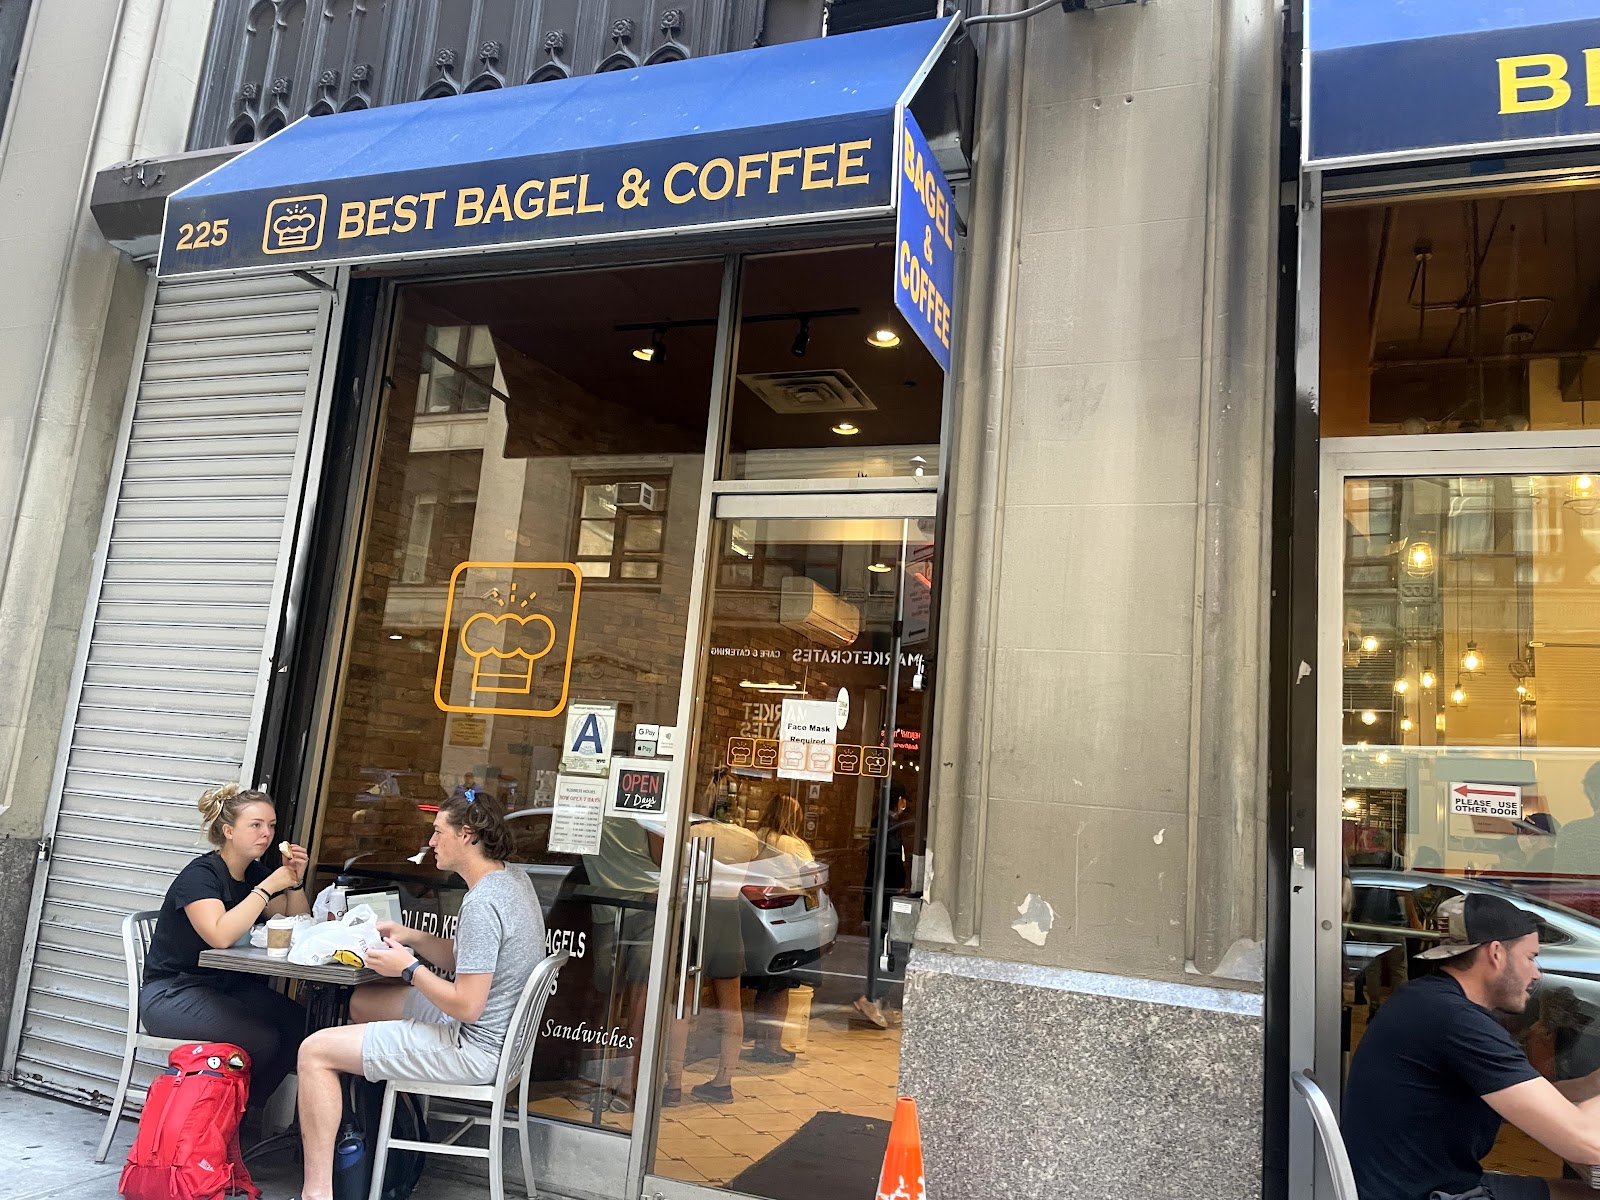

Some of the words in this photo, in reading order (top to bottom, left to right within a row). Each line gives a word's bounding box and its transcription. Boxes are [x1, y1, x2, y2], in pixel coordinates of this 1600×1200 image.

[1495, 47, 1600, 115] B
[176, 218, 229, 251] 225
[337, 189, 446, 240] BEST
[454, 173, 605, 227] BAGEL
[616, 167, 650, 210] &
[662, 137, 873, 205] COFFEE
[903, 125, 953, 251] BAGEL
[923, 224, 933, 266] &
[899, 239, 952, 350] COFFEE
[571, 713, 603, 754] A
[645, 729, 655, 738] Pay
[787, 723, 807, 732] Face
[809, 724, 831, 733] Mask
[790, 736, 826, 745] Required
[642, 745, 652, 753] Pay
[621, 773, 660, 794] OPEN
[623, 793, 630, 806] 7
[634, 794, 657, 808] Days
[1455, 798, 1491, 807] PLEASE
[1498, 801, 1518, 809] USE
[1455, 805, 1488, 814] OTHER
[1490, 807, 1518, 816] DOOR
[401, 909, 439, 936] OLLED,
[545, 928, 587, 958] AGELS
[541, 1018, 635, 1050] Sandwiches
